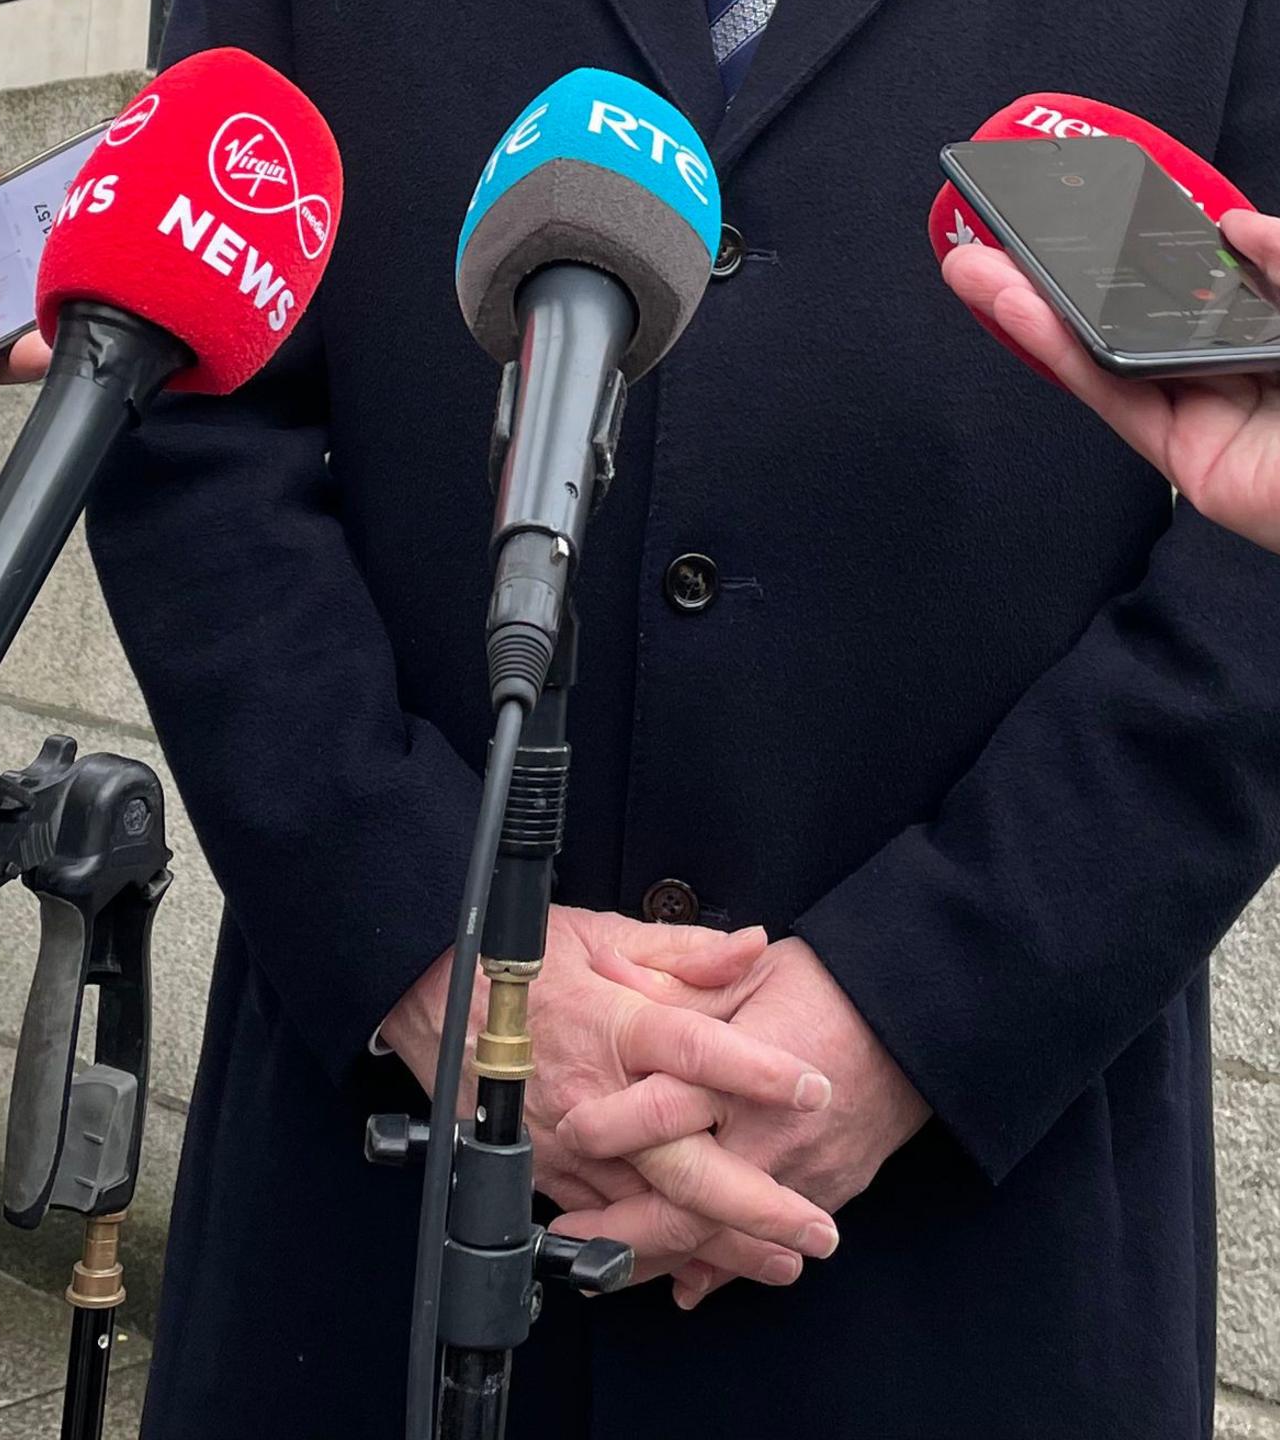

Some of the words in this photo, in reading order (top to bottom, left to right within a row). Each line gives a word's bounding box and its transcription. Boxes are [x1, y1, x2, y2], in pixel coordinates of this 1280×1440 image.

[587, 100, 709, 206] RTÉ
[1014, 106, 1110, 138] ne
[225, 133, 288, 198] Virgin
[301, 205, 326, 241] media
[156, 193, 296, 332] NEWS
